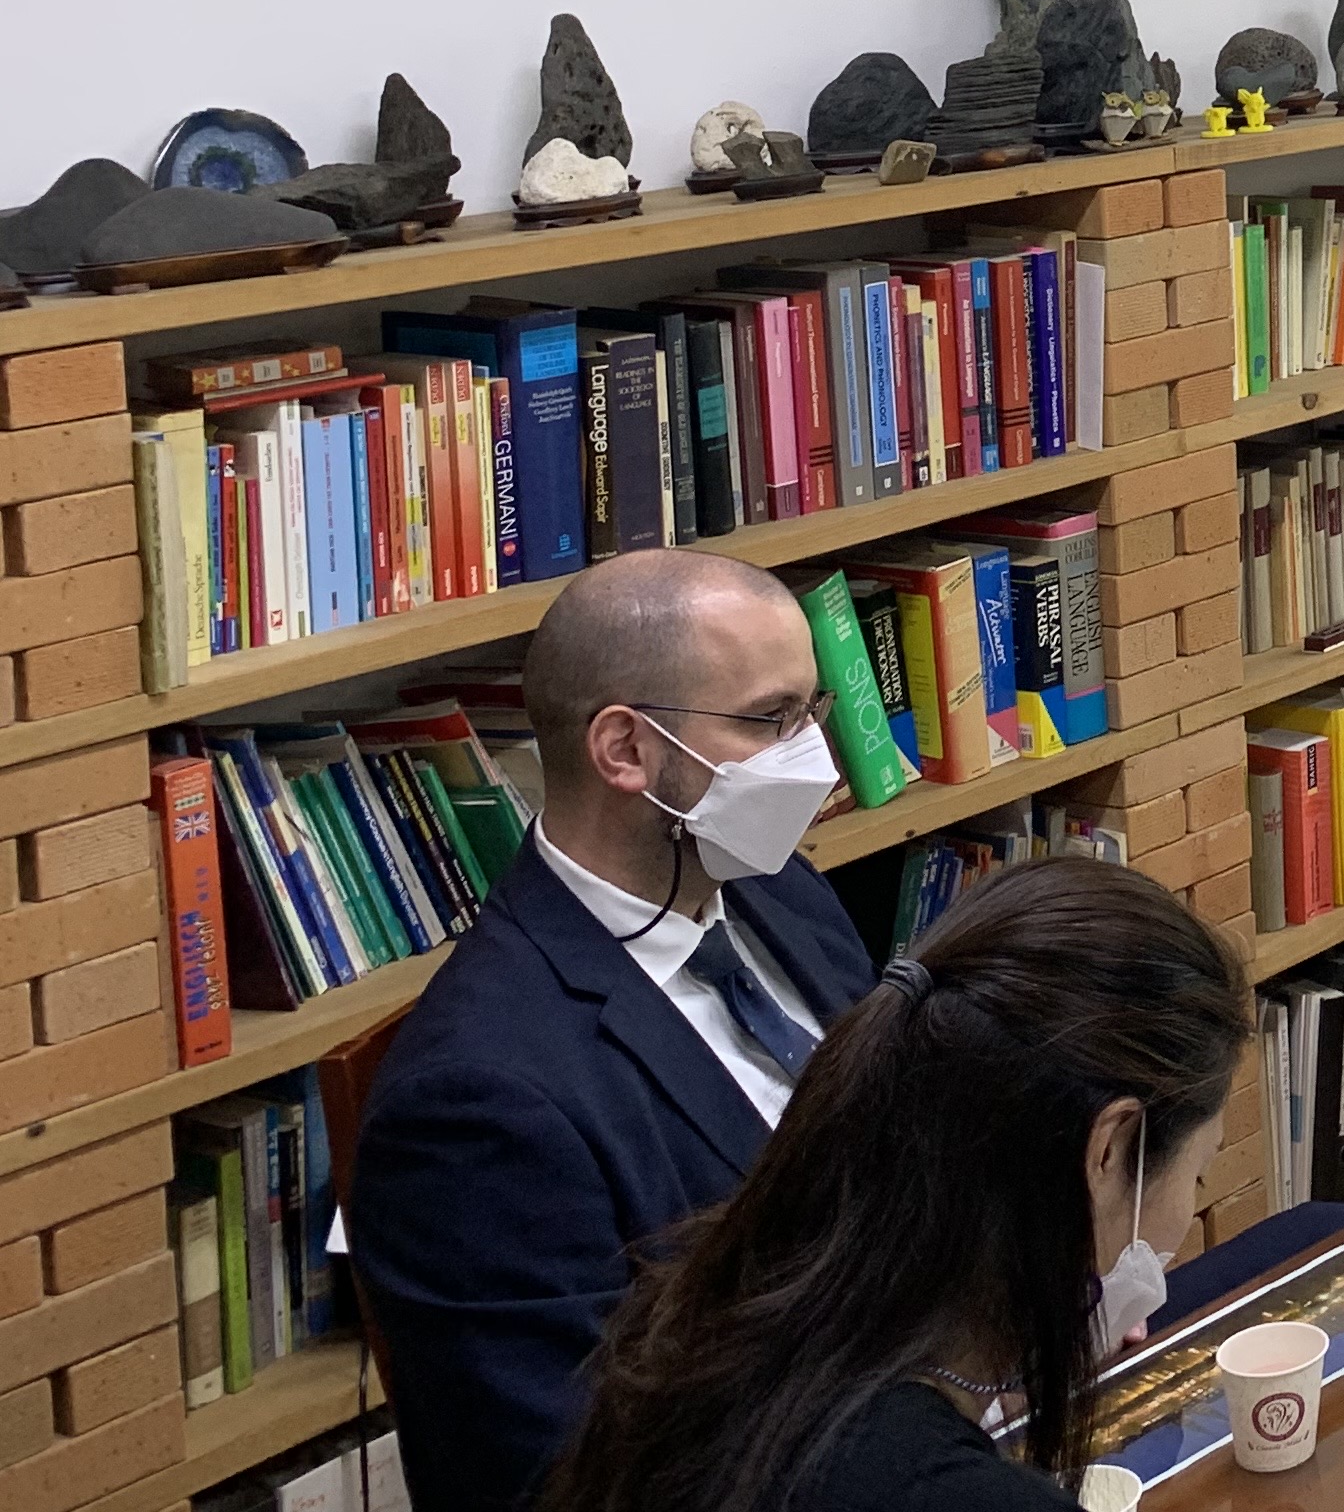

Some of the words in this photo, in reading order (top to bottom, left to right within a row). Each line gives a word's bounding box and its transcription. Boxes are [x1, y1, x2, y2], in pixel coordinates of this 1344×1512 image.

[872, 293, 882, 345] PHONETICS
[875, 347, 884, 366] AND
[1048, 336, 1057, 382] Linguistics
[500, 394, 512, 436] Oxford
[587, 364, 609, 454] Language
[876, 368, 887, 427] PHONOLOGY
[1051, 391, 1059, 433] Phonetics
[494, 440, 518, 534] GERMAN
[595, 455, 608, 495] Edward
[596, 496, 608, 523] Sapir
[1000, 570, 1010, 620] Language
[1036, 587, 1050, 648] VERBS
[1067, 573, 1089, 676] LANGUAGE
[1084, 570, 1103, 652] ENGLISH
[986, 598, 1007, 664] Activator
[1047, 583, 1062, 668] PHRASAL
[874, 619, 894, 705] DICTIONARY
[883, 615, 903, 703] PRONUNCIATION
[845, 656, 889, 755] PONS
[1308, 745, 1316, 787] WAHRIG
[386, 857, 404, 888] English
[180, 910, 209, 1023] ENGLISCH
